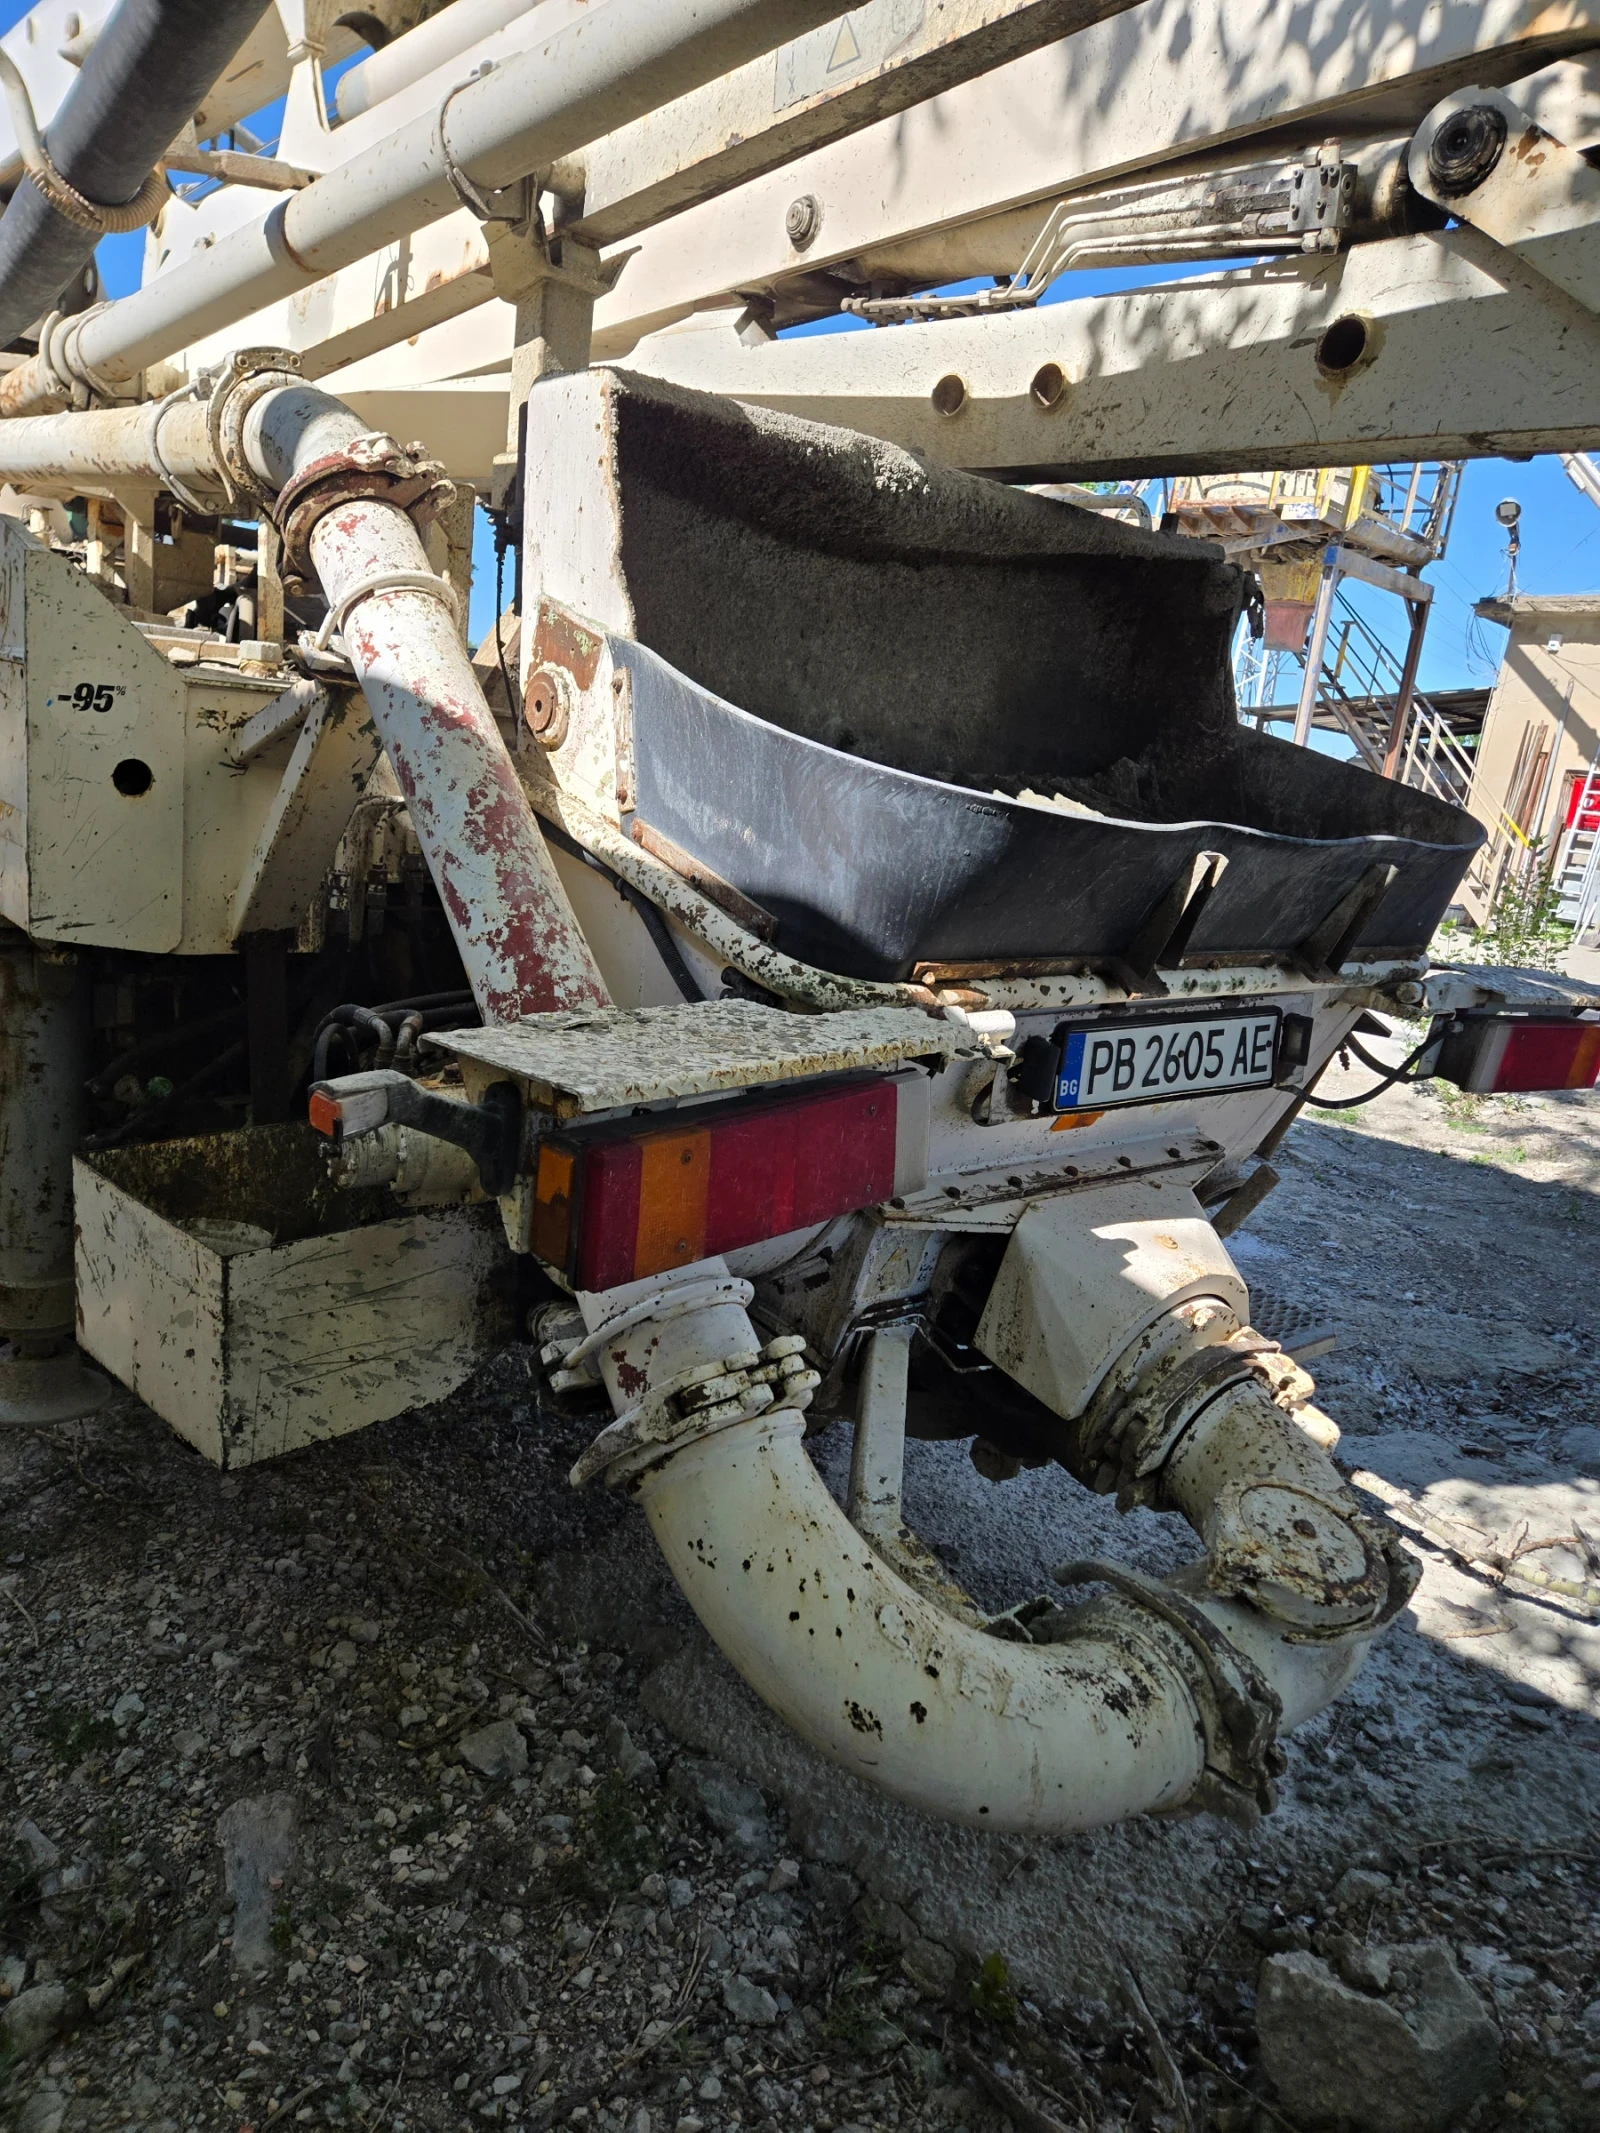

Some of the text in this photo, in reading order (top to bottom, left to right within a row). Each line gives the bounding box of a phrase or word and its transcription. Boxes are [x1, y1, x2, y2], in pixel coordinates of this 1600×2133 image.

[1088, 1025, 1271, 1095] PB 2605 AE
[1059, 1080, 1078, 1097] BG
